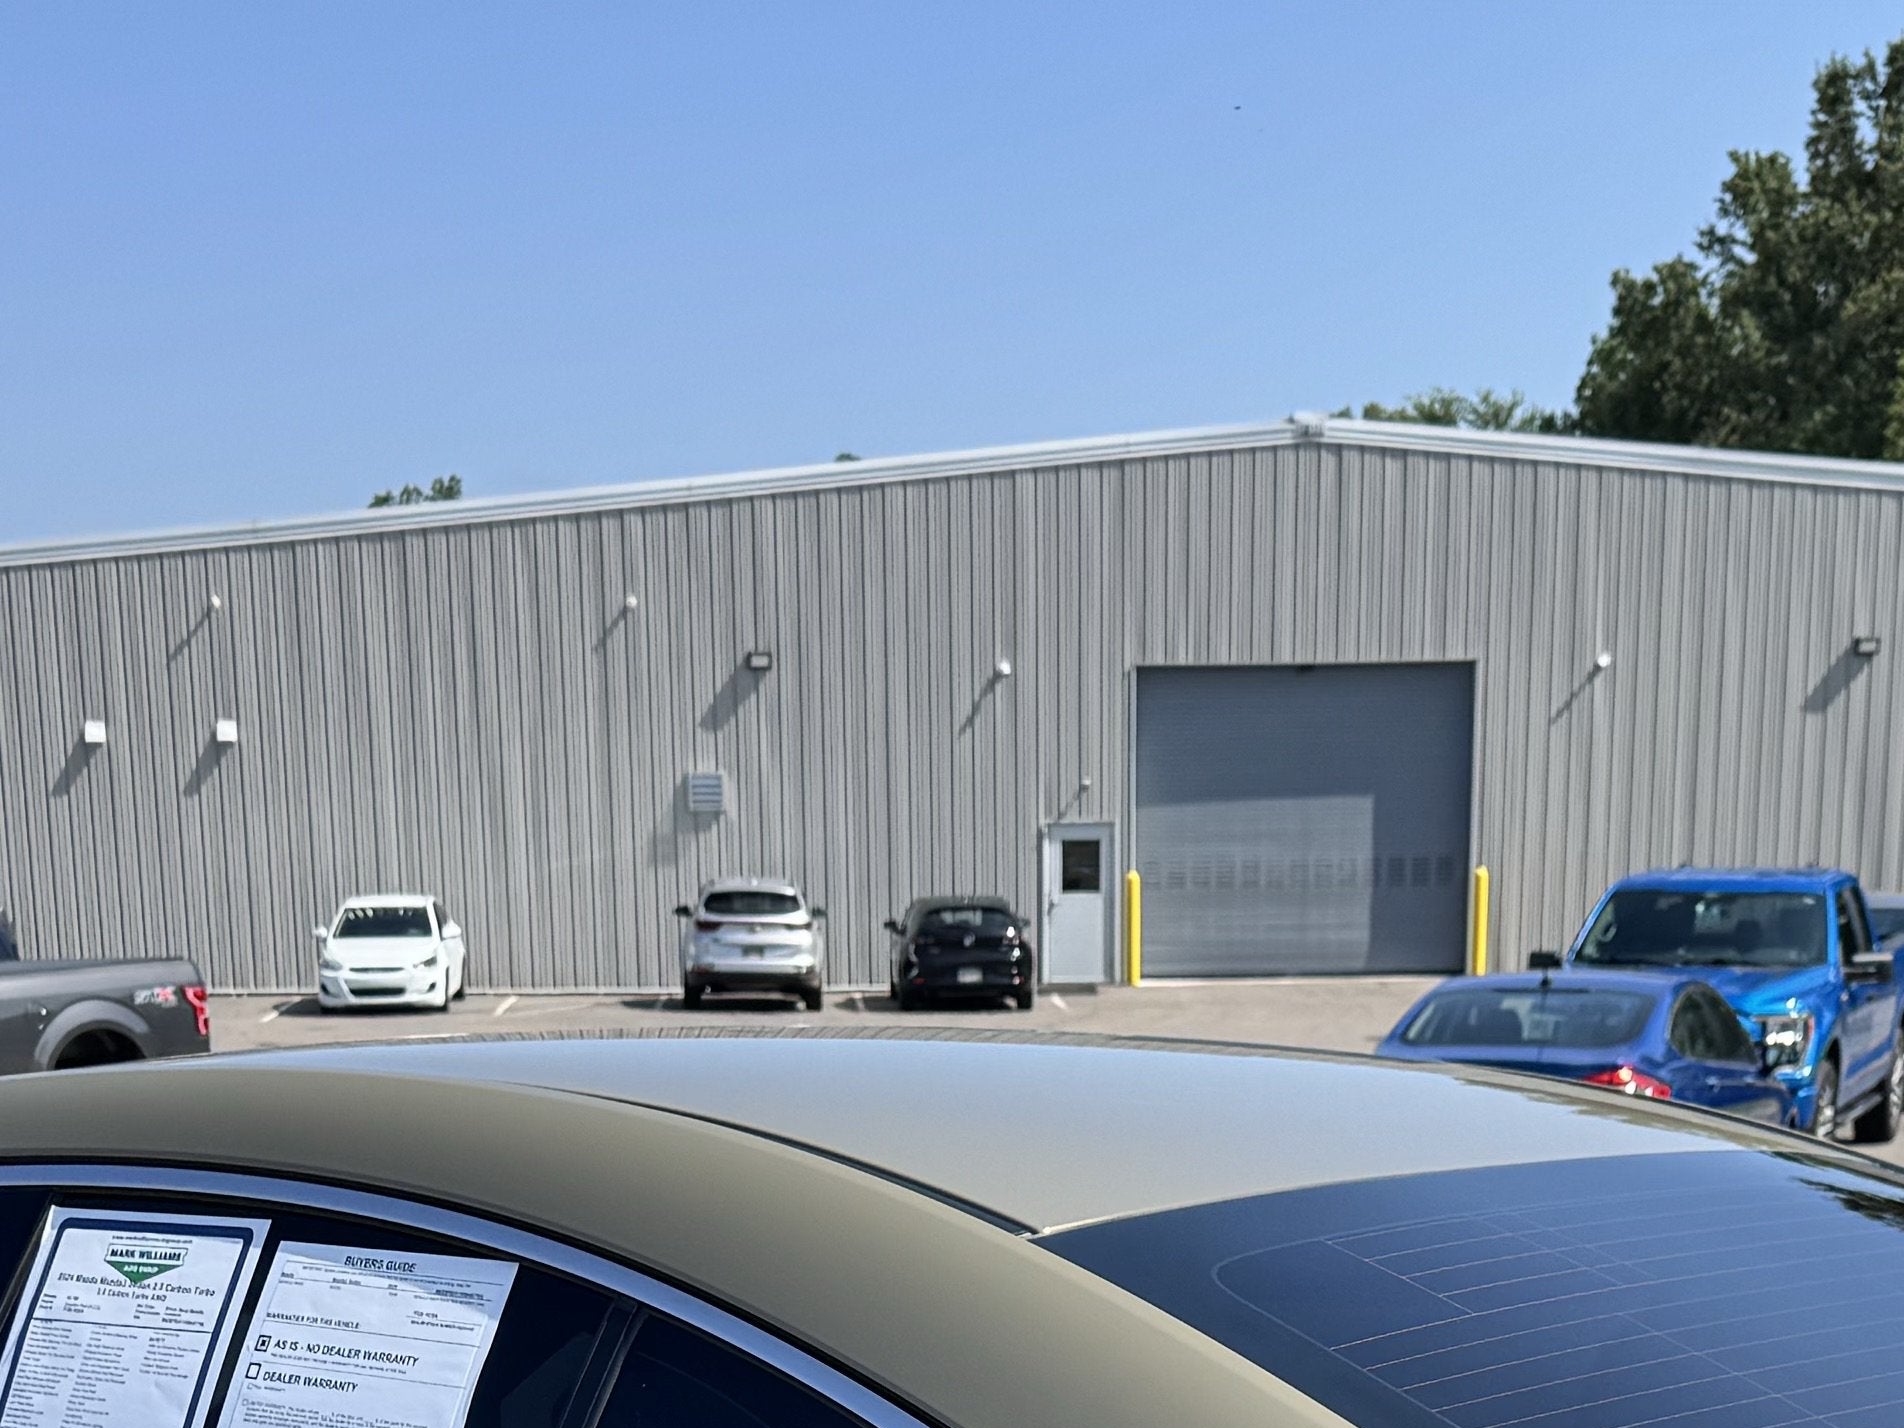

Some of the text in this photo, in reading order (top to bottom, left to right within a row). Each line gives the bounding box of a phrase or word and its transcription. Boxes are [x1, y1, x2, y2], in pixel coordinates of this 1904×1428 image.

[344, 1256, 417, 1272] BUYERS GUIDE
[274, 1340, 288, 1350] AS
[290, 1342, 298, 1351] IS
[306, 1344, 320, 1354] NO
[322, 1346, 361, 1360] DEALER
[363, 1350, 419, 1367] WARRANTY
[263, 1371, 301, 1386] DEALER
[303, 1376, 358, 1392] WARRANTY
